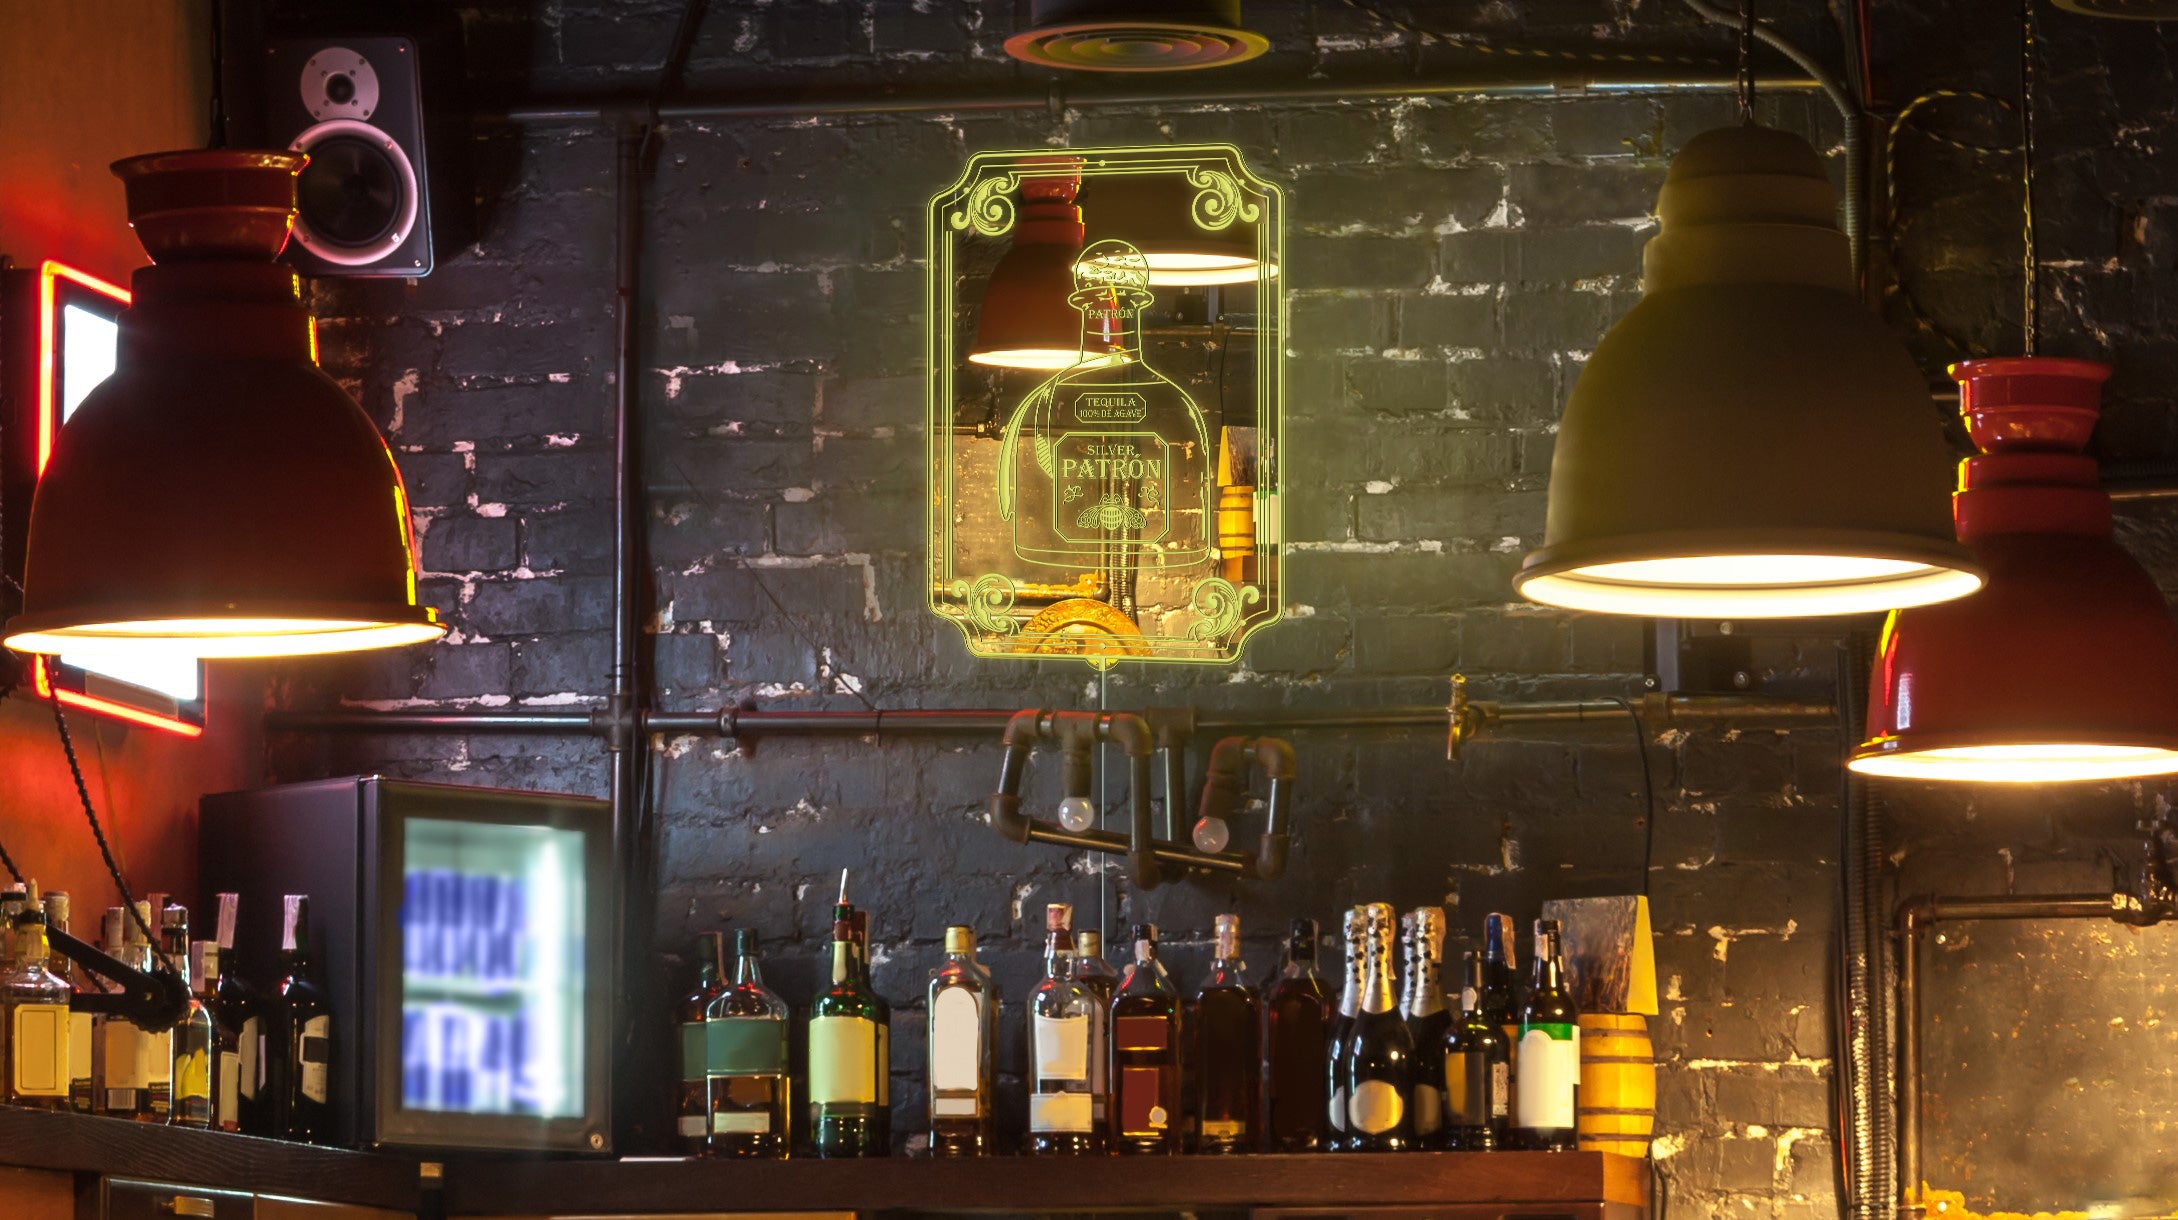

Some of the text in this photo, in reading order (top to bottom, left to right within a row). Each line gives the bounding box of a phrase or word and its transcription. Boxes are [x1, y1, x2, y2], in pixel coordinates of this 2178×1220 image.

[1086, 398, 1136, 407] TEQUILA
[1101, 409, 1112, 418] DE
[1113, 409, 1142, 418] AGAVE
[1087, 444, 1135, 455] SILVER
[1062, 453, 1162, 480] PATRÓN
